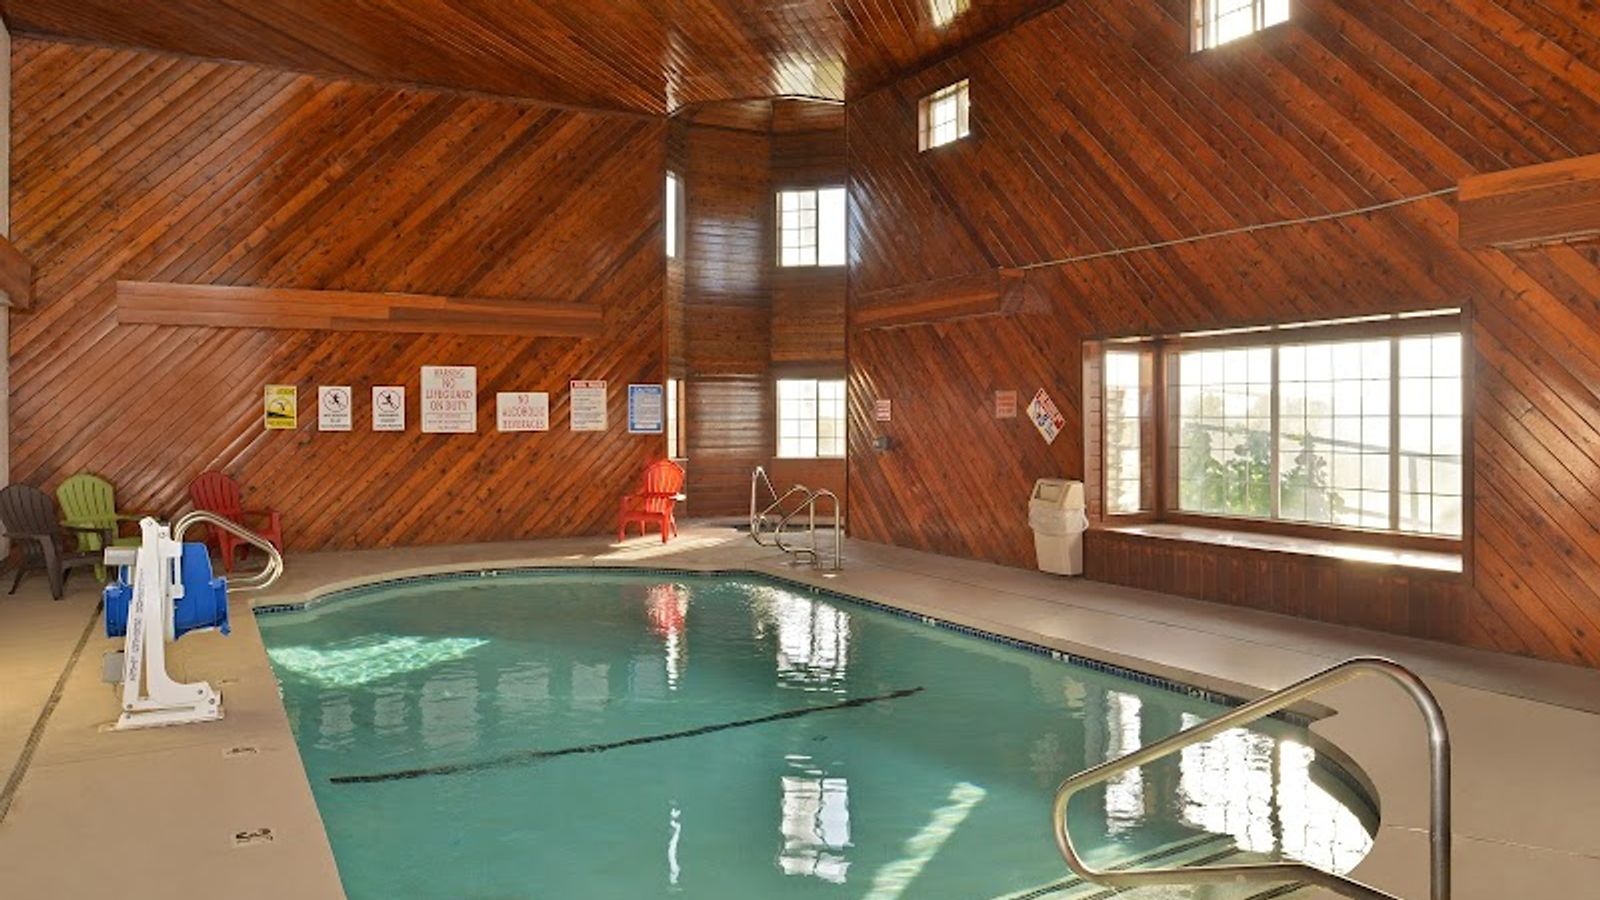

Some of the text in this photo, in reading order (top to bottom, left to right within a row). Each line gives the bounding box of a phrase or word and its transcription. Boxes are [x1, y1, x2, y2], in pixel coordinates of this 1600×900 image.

[425, 389, 473, 399] LIFEGUARD
[430, 400, 468, 411] ON DUTY
